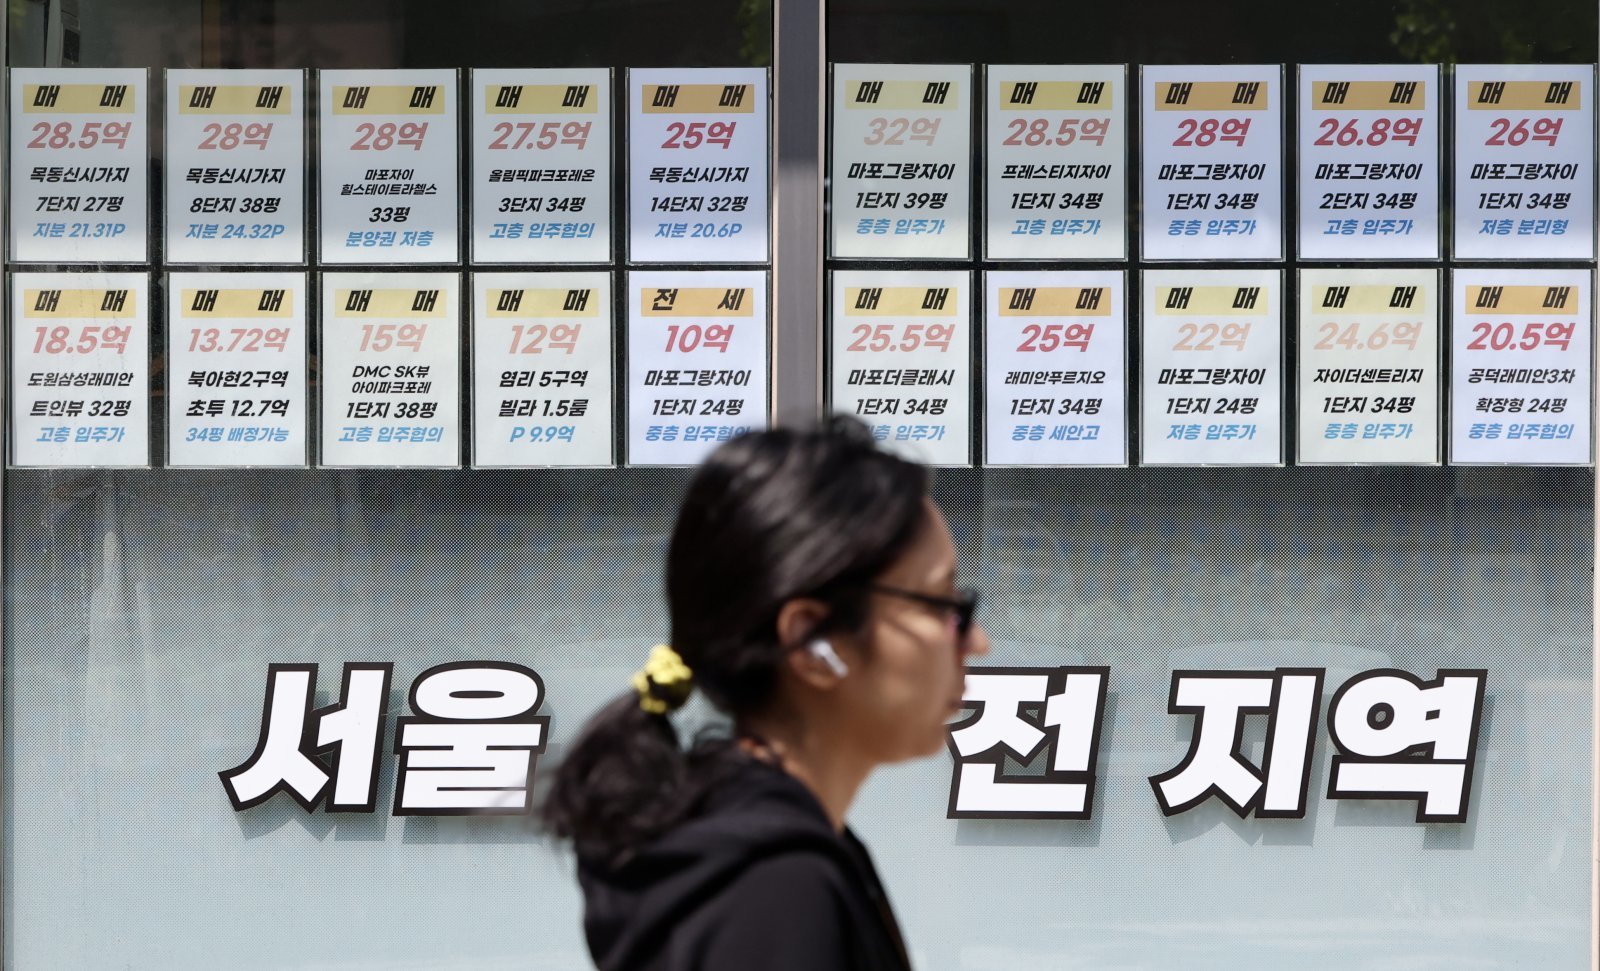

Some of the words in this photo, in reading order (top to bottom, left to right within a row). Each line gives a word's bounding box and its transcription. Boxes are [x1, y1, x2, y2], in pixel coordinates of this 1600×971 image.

[27, 122, 131, 149] 28.5억
[198, 123, 273, 150] 28억
[350, 122, 428, 150] 28억
[488, 122, 592, 150] 27.5억
[661, 122, 736, 149] 25억
[864, 117, 941, 146] 32억
[1003, 119, 1110, 146] 28.5억
[1173, 118, 1251, 147] 28억
[1314, 118, 1423, 146] 26.8억
[1485, 118, 1563, 146] 26억
[31, 167, 129, 182] 목동신시가지
[186, 168, 286, 183] 목동신시가지
[365, 169, 414, 180] 마포자이
[489, 169, 595, 182] 올림픽파크포레온
[650, 167, 749, 183] 목동신시가지
[848, 163, 955, 179] 마포그랑자이
[1001, 165, 1111, 179] 프레스티지자이
[1158, 164, 1266, 180] 마포그랑자이
[1315, 164, 1423, 180] 마포그랑자이
[1471, 164, 1578, 180] 마포그랑자이
[341, 184, 437, 195] 힐스테이트라첼스
[36, 197, 80, 211] 7단지
[83, 197, 124, 212] 27평
[190, 198, 236, 213] 8단지
[240, 198, 281, 213] 38평
[499, 198, 543, 212] 3단지
[546, 197, 586, 212] 34평
[651, 197, 704, 212] 14단지
[707, 196, 748, 212] 32평
[856, 192, 900, 208] 1단지
[904, 193, 948, 209] 39평
[1012, 193, 1056, 209] 1단지
[1059, 193, 1103, 209] 34평
[1167, 193, 1211, 209] 1단지
[1215, 193, 1259, 209] 34평
[1320, 193, 1369, 209] 2단지
[1373, 193, 1417, 209] 34평
[1479, 193, 1523, 209] 1단지
[1527, 193, 1571, 209] 34평
[369, 207, 410, 222] 33평
[33, 223, 66, 237] 지분
[69, 223, 126, 237] 21.31P
[186, 224, 219, 239] 지분
[221, 224, 285, 238] 24.32P
[489, 223, 524, 238] 고층
[528, 223, 595, 238] 입주협의
[655, 223, 688, 238] 지분
[691, 223, 742, 237] 20.6P
[857, 218, 891, 234] 중층
[895, 219, 945, 235] 입주가
[1012, 219, 1046, 235] 고층
[1051, 220, 1101, 235] 입주가
[1168, 220, 1202, 235] 중층
[1206, 220, 1256, 235] 입주가
[1324, 219, 1358, 235] 고층
[1363, 220, 1413, 235] 입주가
[1479, 219, 1514, 235] 저층
[1518, 219, 1569, 235] 분리형
[346, 232, 397, 247] 분양권
[399, 231, 434, 246] 저층
[33, 326, 131, 354] 18.5억
[188, 328, 290, 352] 13.72억
[360, 324, 427, 352] 15억
[509, 324, 581, 354] 12억
[665, 325, 734, 353] 10억
[847, 324, 955, 352] 25.5억
[1016, 324, 1094, 352] 25억
[1172, 323, 1251, 351] 22억
[1314, 322, 1423, 350] 24.6억
[1467, 323, 1575, 351] 20.5억
[28, 373, 133, 386] 도원삼성래미안
[188, 371, 288, 387] 북아현2구역
[352, 366, 391, 377] DMC
[394, 366, 430, 378] SK뷰
[500, 371, 535, 387] 염리
[539, 371, 588, 387] 5구역
[644, 370, 751, 386] 마포그랑자이
[848, 370, 955, 385] 마포더클래시
[1005, 371, 1105, 384] 래미안푸르지오
[1158, 369, 1266, 385] 마포그랑자이
[1314, 369, 1423, 383] 자이더센트리지
[1468, 369, 1575, 383] 공덕래미안3차
[352, 382, 431, 393] 아이파크포레
[30, 401, 84, 417] 트인뷰
[88, 401, 131, 416] 32평
[186, 400, 225, 417] 초투
[231, 400, 289, 417] 12.7억
[347, 402, 390, 418] 1단지
[394, 402, 438, 418] 38평
[499, 400, 537, 417] 빌라
[543, 399, 588, 416] 1.5룸
[653, 399, 697, 415] 1단지
[700, 399, 744, 415] 24평
[857, 399, 900, 414] 1단지
[904, 399, 948, 415] 34평
[1011, 399, 1055, 415] 1단지
[1058, 399, 1102, 415] 34평
[1167, 398, 1211, 414] 1단지
[1214, 398, 1258, 414] 24평
[1324, 397, 1367, 413] 1단지
[1371, 397, 1415, 413] 34평
[1476, 398, 1524, 413] 확장형
[1527, 399, 1567, 413] 24평
[36, 426, 71, 442] 고층
[75, 427, 125, 442] 입주가
[186, 428, 224, 442] 34평
[227, 427, 289, 442] 배정가능
[338, 426, 373, 442] 고층
[377, 427, 444, 442] 입주협의
[510, 427, 525, 442] P
[530, 426, 575, 442] 9.9억
[646, 425, 679, 441] 중층
[896, 425, 945, 441] 입주가
[1012, 425, 1046, 441] 중층
[1049, 425, 1100, 440] 세안고
[1167, 424, 1202, 440] 저층
[1206, 425, 1256, 440] 입주가
[1324, 423, 1358, 439] 중층
[1362, 424, 1413, 439] 입주가
[1469, 423, 1503, 439] 중층
[1507, 424, 1574, 439] 입주협의
[218, 661, 550, 816] 서울
[946, 666, 1110, 820] 전
[1148, 668, 1488, 824] 지역
